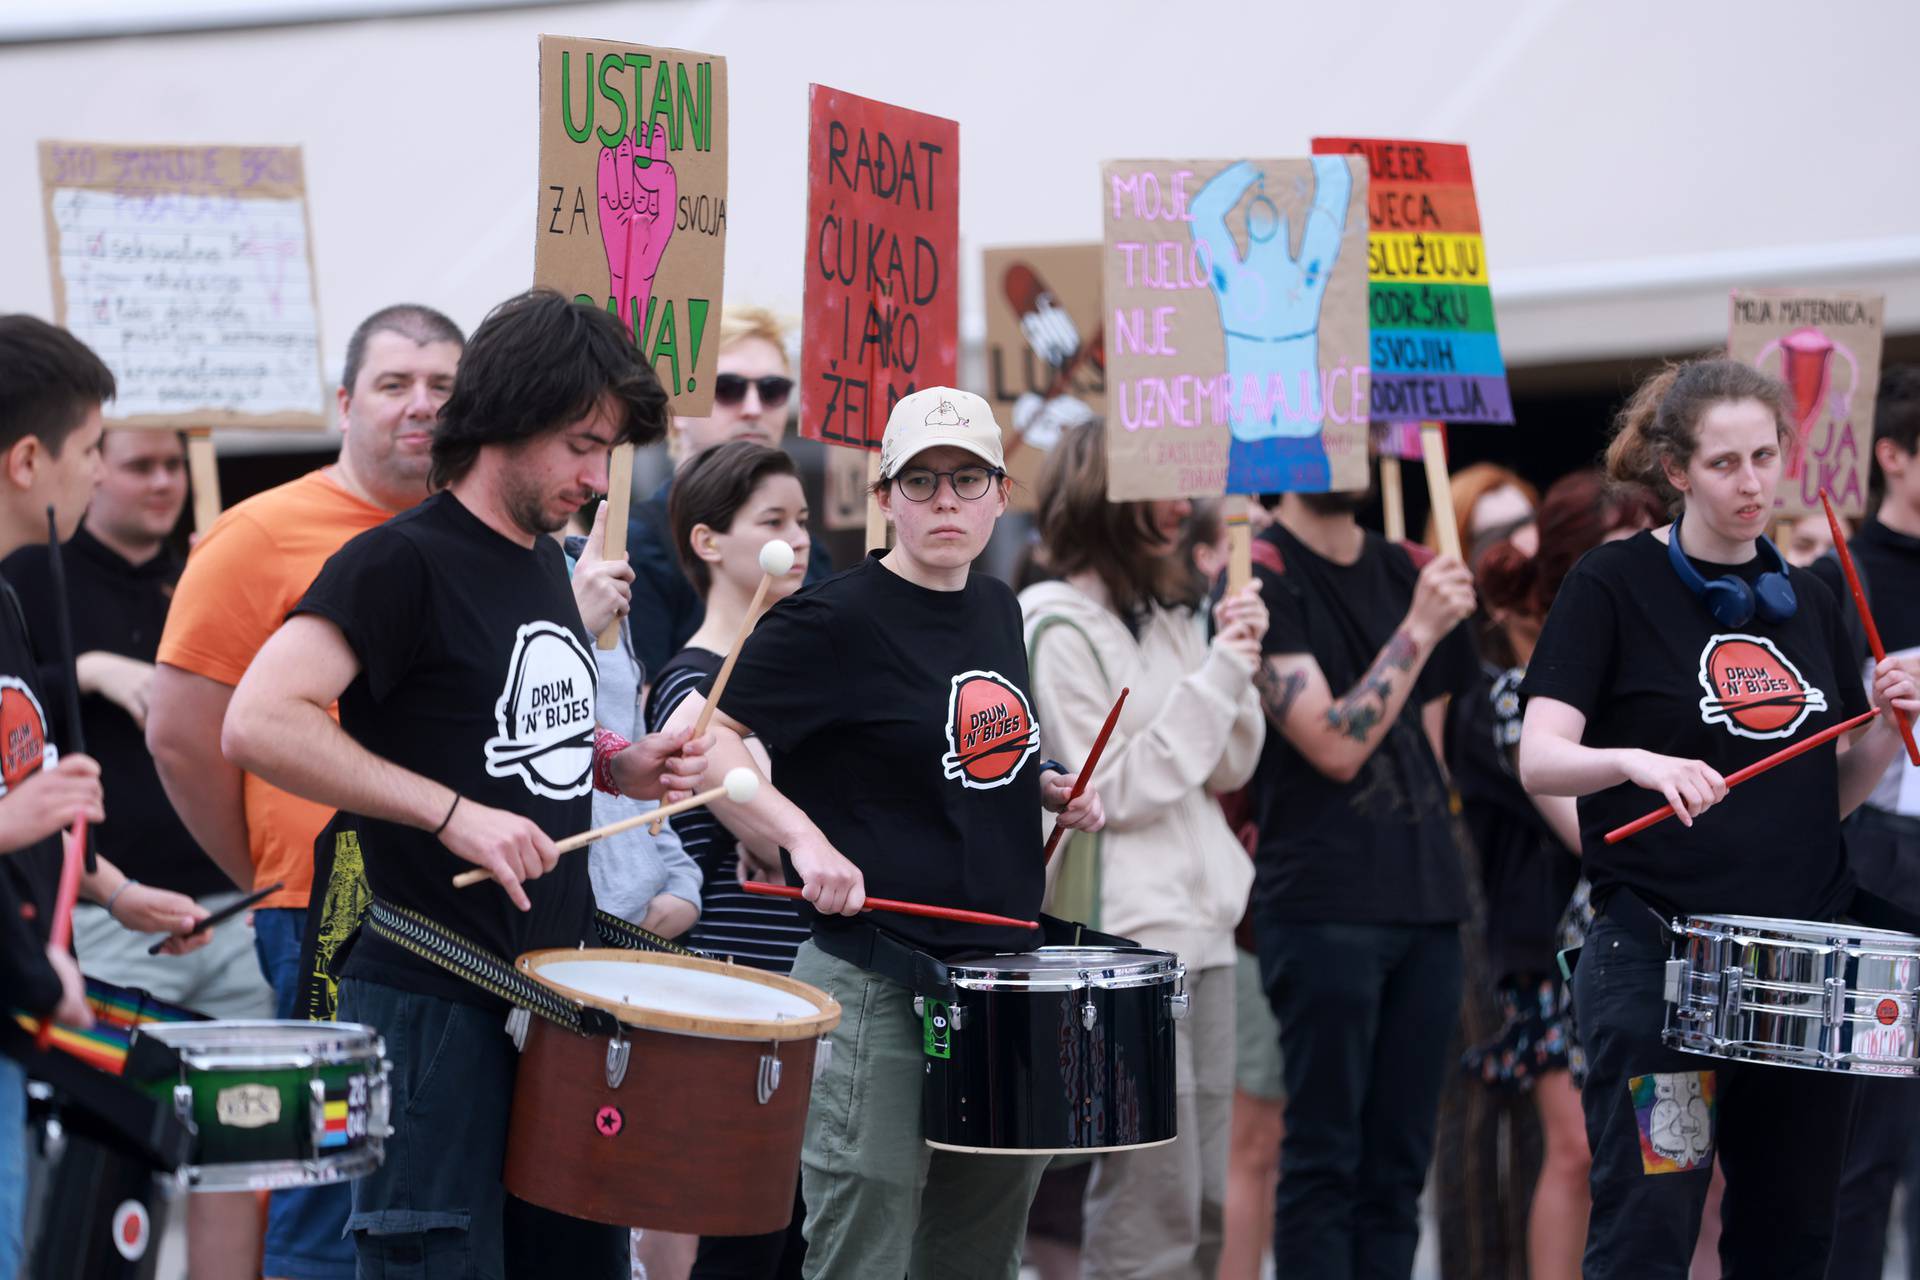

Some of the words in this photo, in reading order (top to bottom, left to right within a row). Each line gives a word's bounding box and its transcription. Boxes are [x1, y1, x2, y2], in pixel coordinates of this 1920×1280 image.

[562, 51, 711, 151] USTANI
[829, 120, 943, 211] RAĐAT
[1349, 143, 1432, 181] UEER
[550, 186, 589, 235] ZA
[677, 195, 727, 237] SVOJA
[1111, 170, 1197, 221] MOJE
[1368, 192, 1441, 229] JECA
[819, 199, 857, 286] ĆU
[866, 223, 940, 306] KAD
[1114, 239, 1212, 290] TIJELO
[1369, 233, 1479, 276] SLUŽUJU
[1373, 285, 1469, 327] ODRŠKU
[843, 296, 850, 361] I
[858, 300, 919, 374] AKO
[1115, 305, 1177, 357] NIJE
[1375, 336, 1456, 371] SVOJIH
[1774, 462, 1862, 509] UKA
[531, 677, 574, 709] DRUM
[1725, 667, 1769, 681] DRUM
[1746, 679, 1791, 694] BIJES
[545, 698, 589, 729] BIJES
[970, 703, 1008, 731] DRUM
[983, 715, 1020, 743] BIJES
